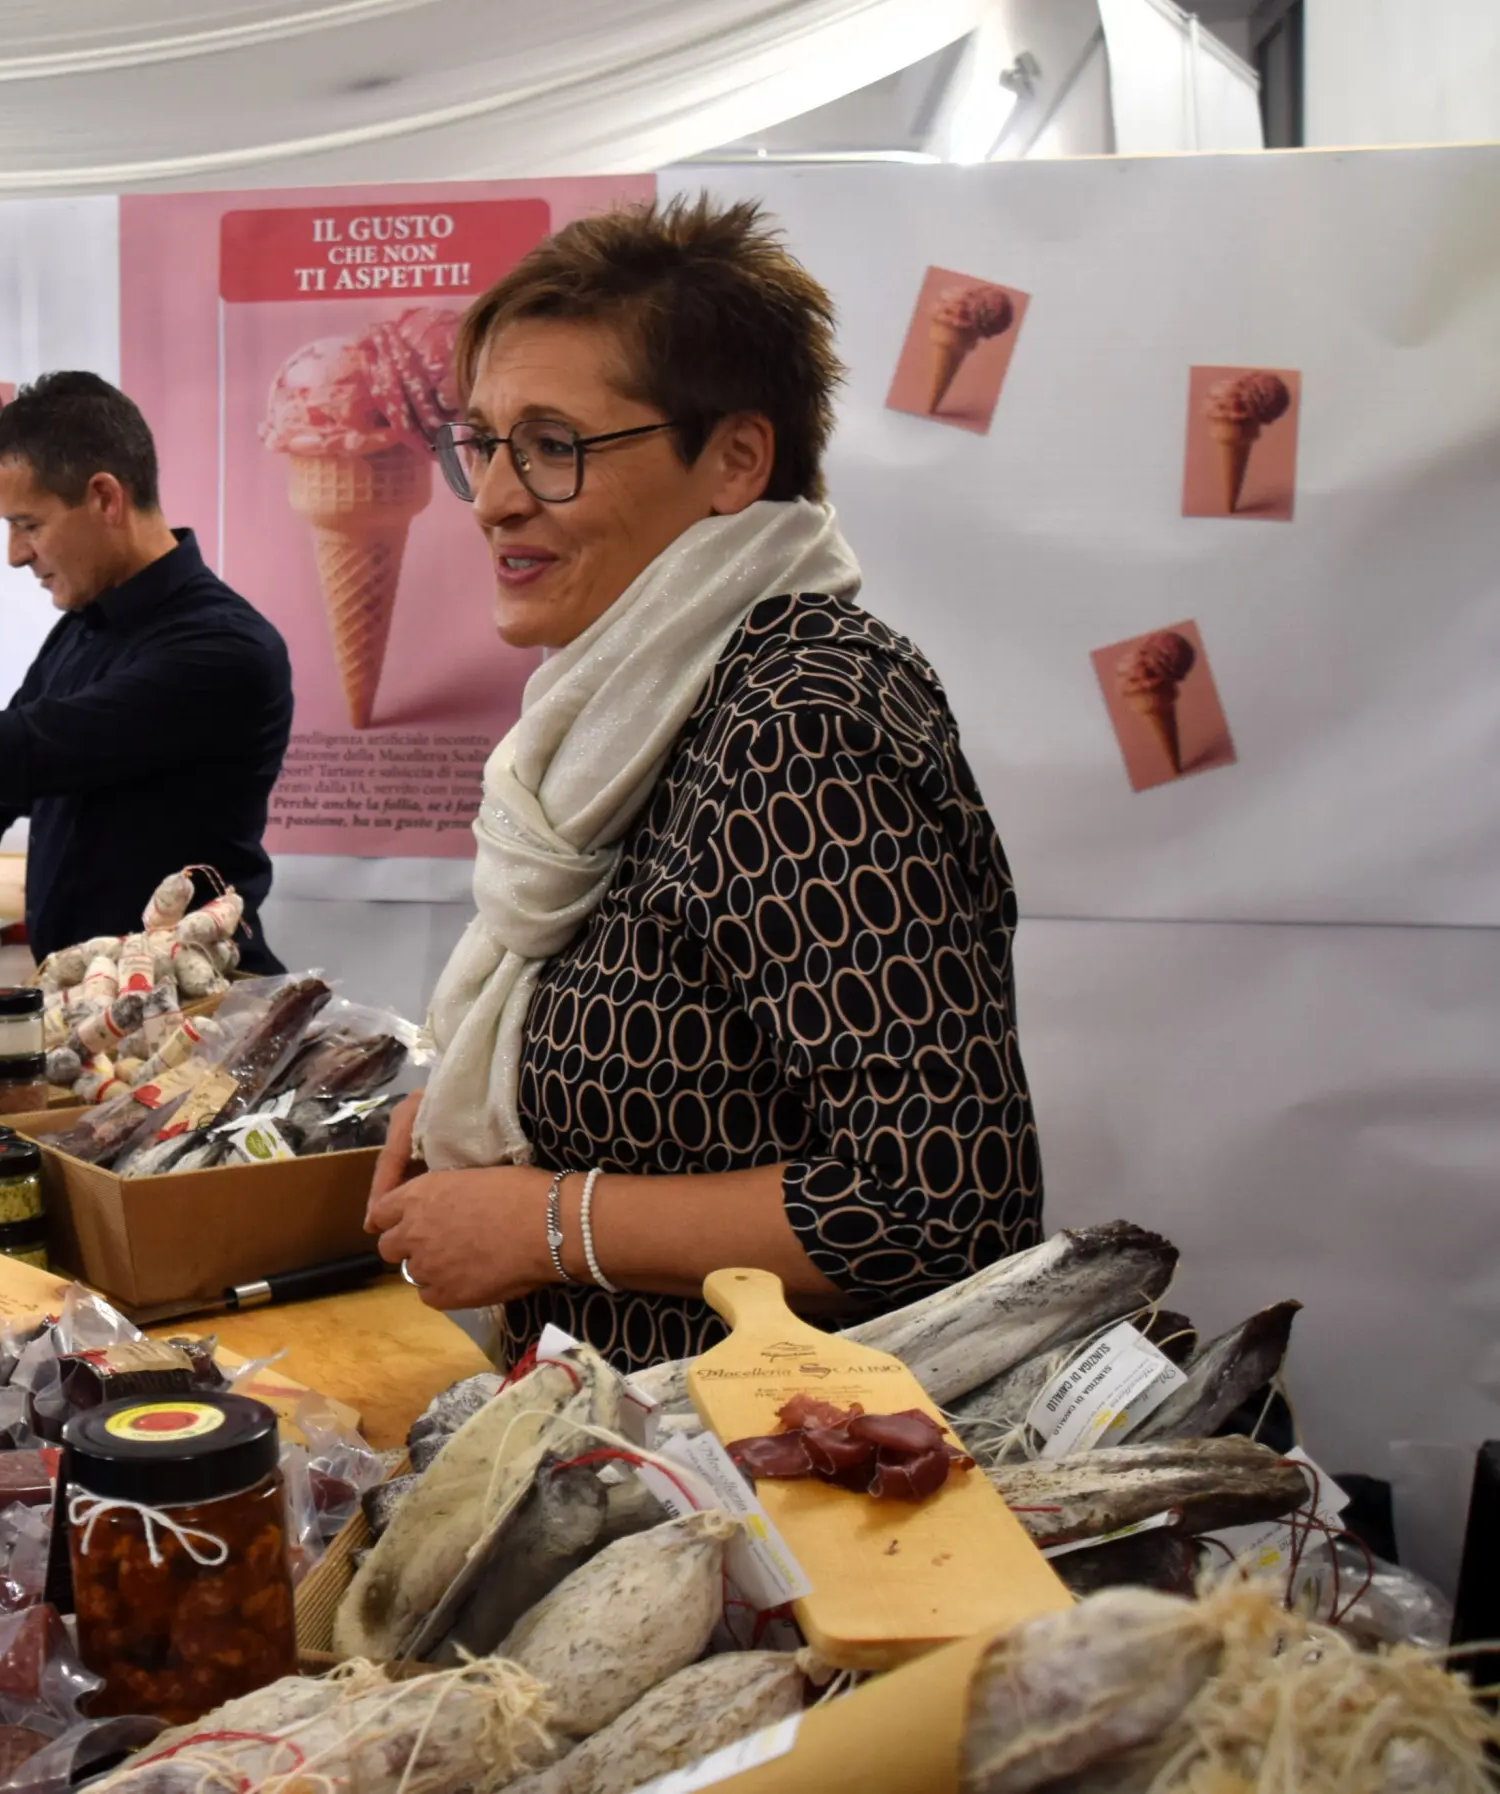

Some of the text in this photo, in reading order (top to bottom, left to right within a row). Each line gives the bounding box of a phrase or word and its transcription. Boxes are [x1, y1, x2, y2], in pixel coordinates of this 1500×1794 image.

[313, 214, 454, 242] IL GUSTO
[328, 244, 437, 265] CHE NON
[295, 263, 471, 291] TI ASPETTI!
[321, 797, 362, 810] anche
[1045, 1343, 1112, 1412] SLINZIGA DI CAVALLO
[1081, 1364, 1113, 1395] SLINZIGA
[1074, 1395, 1085, 1406] DI
